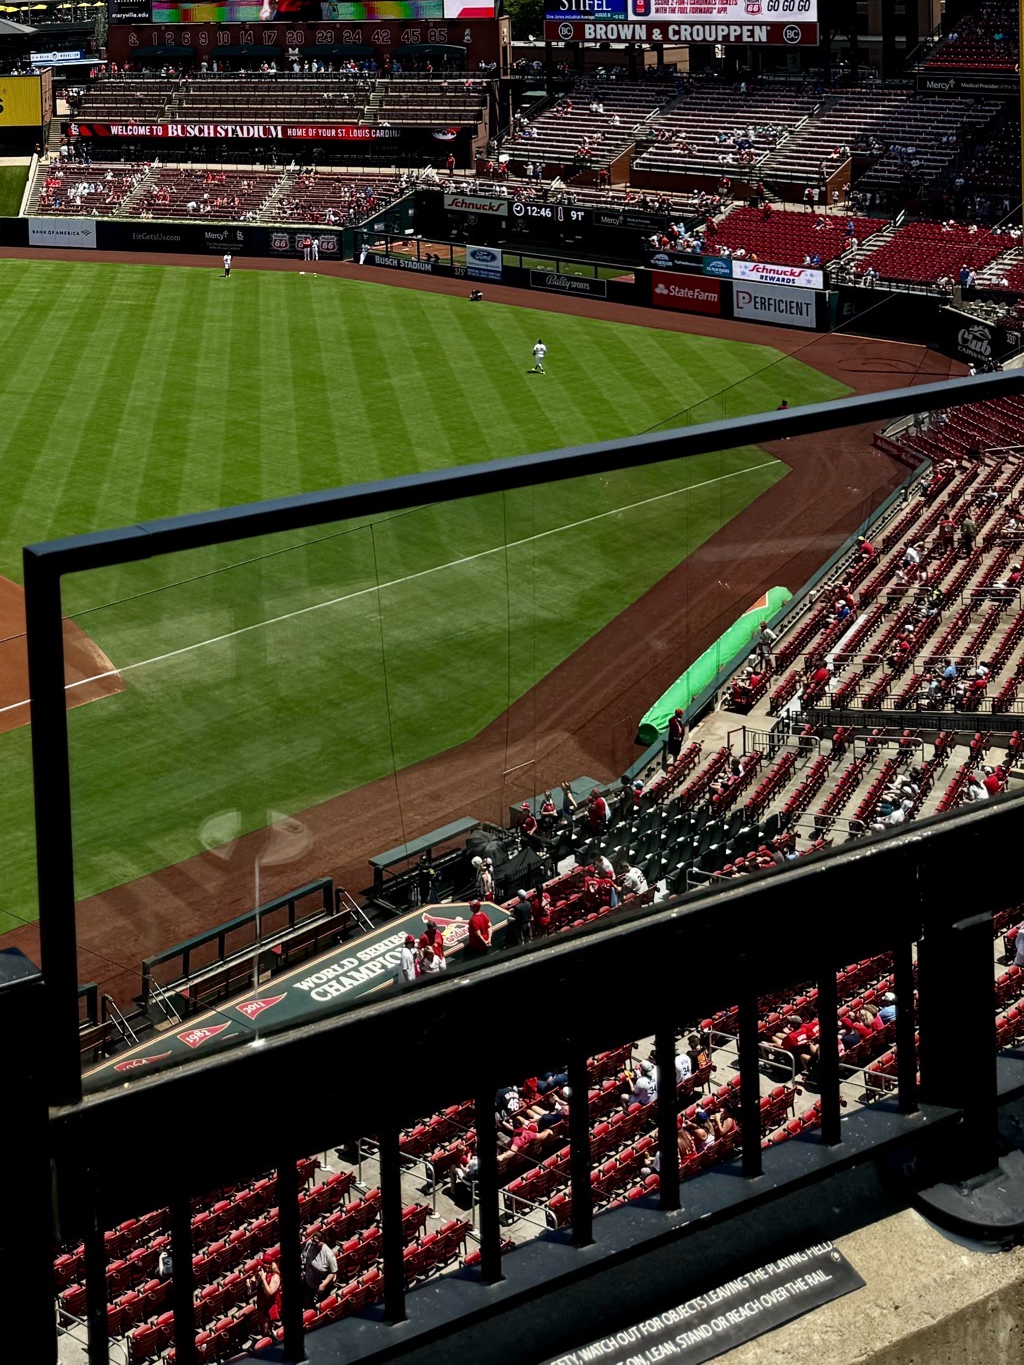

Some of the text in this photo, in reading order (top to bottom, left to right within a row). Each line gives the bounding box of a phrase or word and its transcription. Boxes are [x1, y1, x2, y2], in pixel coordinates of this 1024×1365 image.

[654, 6, 689, 14] WITH THE FUEL
[767, 0, 811, 12] GO GO GO
[151, 28, 448, 46] 1 2 6 9 10 14 17 20 23 24 42 45 85
[584, 23, 768, 43] BROWN & CROUPPEN
[926, 80, 950, 90] Mercy
[110, 125, 151, 135] WELCOME
[152, 125, 163, 135] TO
[167, 124, 215, 137] BUSCH
[216, 124, 283, 138] STADIUM
[287, 128, 307, 137] HOME
[308, 128, 317, 137] OF
[318, 128, 336, 137] YOUR
[337, 128, 347, 137] ST.
[349, 128, 370, 137] LOUIS
[447, 197, 505, 212] Schnucks
[527, 206, 585, 221] 12:46 91°
[600, 215, 620, 226] Mercy
[132, 231, 181, 242] HeGetsUs.com
[205, 231, 224, 240] Mercy
[274, 239, 286, 247] 66
[321, 241, 334, 249] 66
[374, 255, 432, 272] BUSCH STADIUM
[475, 251, 492, 261] Ford
[748, 264, 805, 278] Schnucks
[546, 274, 590, 291] Bally SPORTS
[759, 275, 796, 285] REWARDS
[736, 290, 812, 317] PERFICIENT
[957, 325, 992, 356] Club
[293, 930, 410, 992] WORLD SERIES
[242, 1000, 267, 1015] 2011
[185, 1028, 212, 1044] 1982
[578, 1337, 619, 1361] WATCH
[616, 1325, 642, 1345] OUT
[638, 1317, 665, 1336] FOR
[661, 1296, 708, 1325] OBJECTS
[703, 1275, 750, 1305] LEAVING
[744, 1267, 769, 1285] THE
[765, 1250, 809, 1276] PLAYING
[645, 1269, 833, 1363] LEAN, STAND OR REACH OVER THE RAIL.
